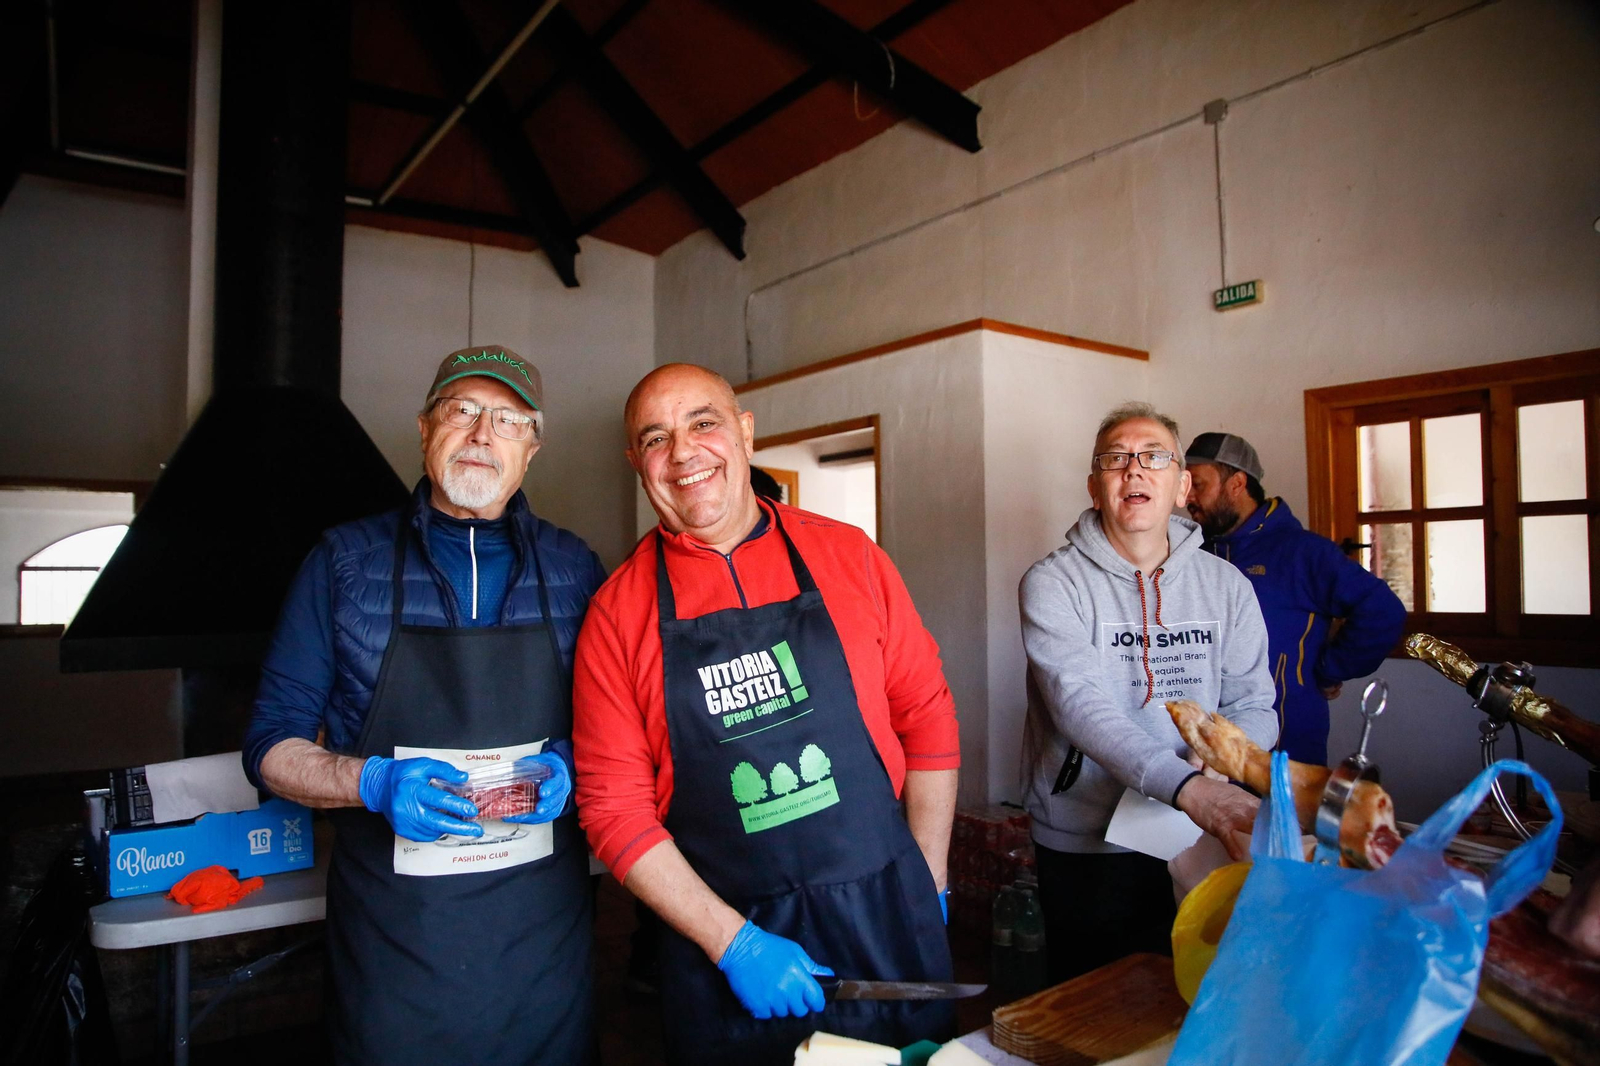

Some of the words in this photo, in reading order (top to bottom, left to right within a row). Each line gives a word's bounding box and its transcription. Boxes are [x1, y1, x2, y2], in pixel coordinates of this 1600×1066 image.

[1215, 283, 1254, 304] SALIDA
[1156, 630, 1213, 648] SMITH
[697, 650, 778, 691] VITORIA
[1155, 666, 1185, 676] equips
[1131, 679, 1142, 687] all
[1156, 679, 1164, 687] of
[1166, 677, 1202, 687] athletes
[705, 672, 786, 715] GASTEIZ
[1165, 690, 1186, 698] 1970.
[723, 708, 755, 728] green
[755, 694, 791, 717] capital
[252, 831, 268, 847] 16
[116, 847, 185, 877] Blanco
[452, 855, 487, 864] FASHION
[488, 850, 509, 860] CLUB
